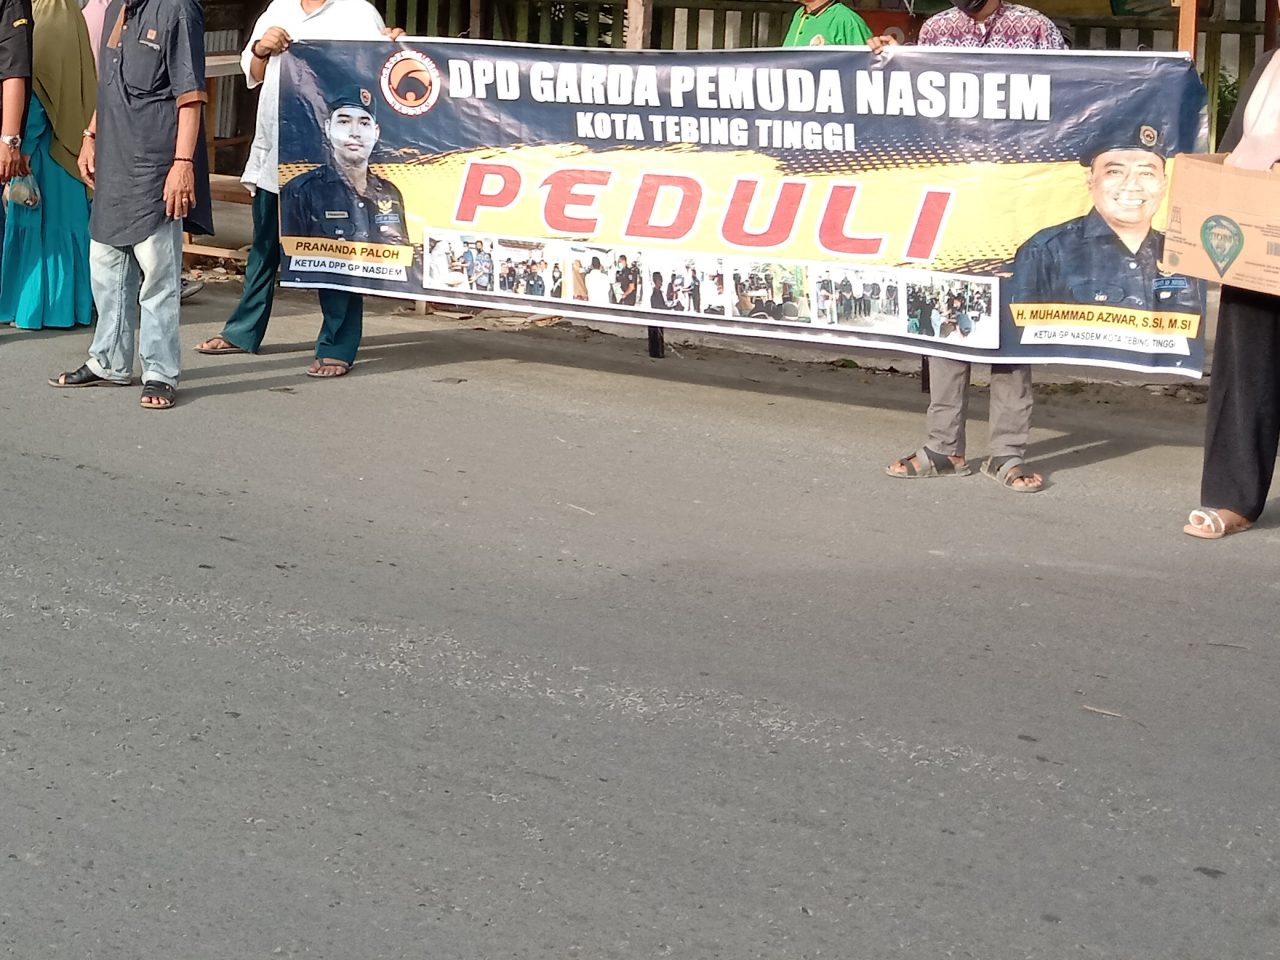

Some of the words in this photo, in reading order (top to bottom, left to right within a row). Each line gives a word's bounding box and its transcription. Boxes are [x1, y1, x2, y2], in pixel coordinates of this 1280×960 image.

[448, 59, 521, 101] DPD
[529, 62, 661, 107] GARDA
[669, 65, 845, 114] PEMUDA
[856, 69, 1052, 121] NASDEM
[576, 111, 645, 141] KOTA
[648, 114, 749, 146] TEBING
[755, 119, 856, 151] TINGGI
[454, 160, 953, 260] PEDULI
[295, 241, 357, 256] PRANANDA
[360, 247, 400, 259] PALOH
[294, 259, 327, 268] KETUA
[328, 260, 346, 270] DPP
[347, 263, 360, 272] GP
[362, 266, 402, 276] NASDEM
[1016, 310, 1027, 320] H.
[1029, 309, 1095, 322] MUHAMMAD
[1096, 312, 1139, 328] AZWAR,
[1141, 317, 1166, 331] S.SI,
[1167, 319, 1191, 331] M.SI
[1033, 330, 1057, 339] KETUA
[1058, 330, 1070, 339] GP
[1071, 331, 1101, 341] NASDEM
[1151, 338, 1176, 349] TINGGI
